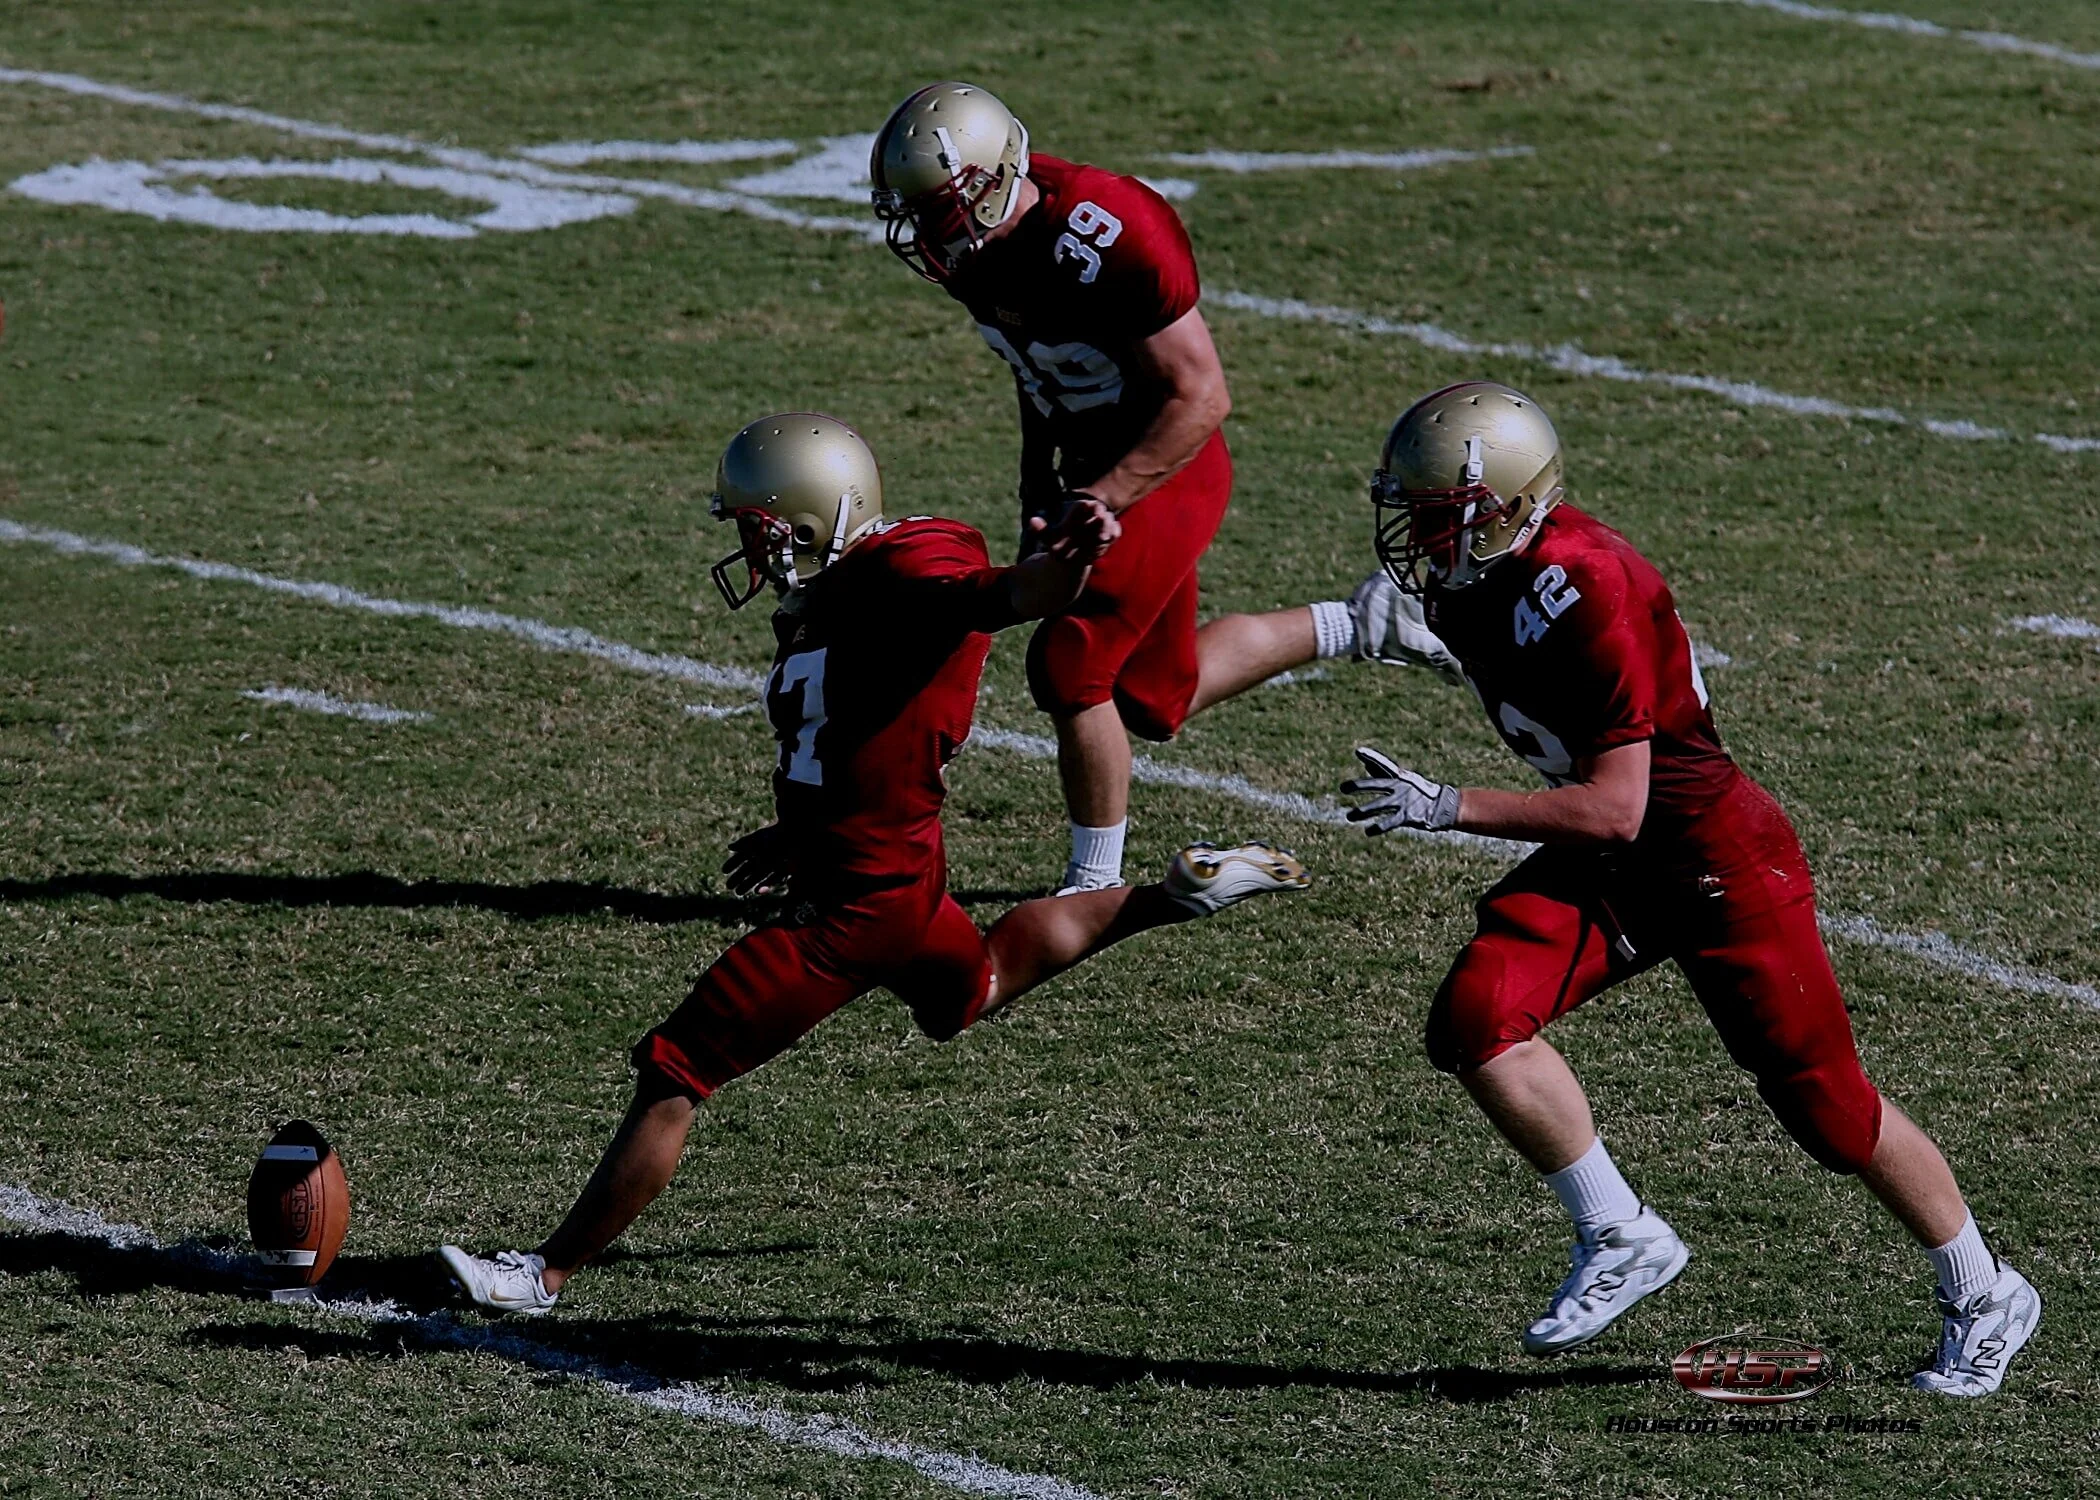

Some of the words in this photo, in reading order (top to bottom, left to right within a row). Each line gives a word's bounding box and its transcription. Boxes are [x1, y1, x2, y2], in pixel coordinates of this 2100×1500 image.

[1053, 200, 1123, 284] 39
[1513, 564, 1581, 647] 42
[764, 647, 828, 787] 7
[1484, 690, 1572, 788] 2
[1974, 1338, 2006, 1369] N
